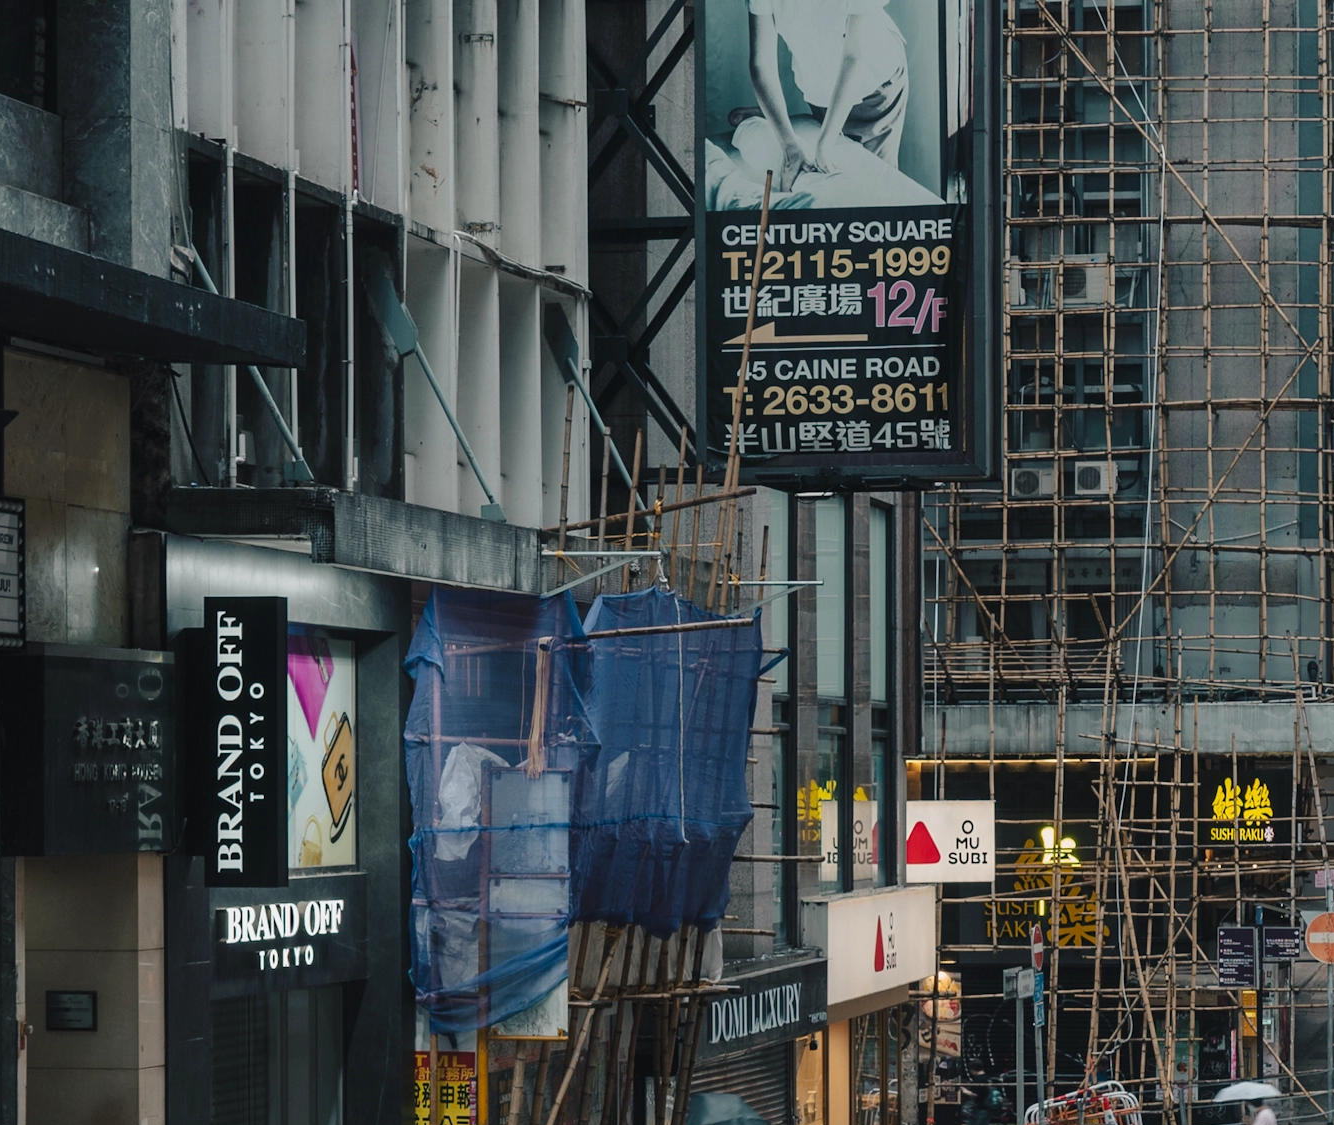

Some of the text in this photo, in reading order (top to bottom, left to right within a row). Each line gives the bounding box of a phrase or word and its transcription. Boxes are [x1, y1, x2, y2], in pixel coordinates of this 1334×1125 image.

[721, 218, 953, 246] CENTURY SQUARE
[721, 280, 949, 334] 世紀廣場 12/F
[736, 356, 941, 381] 45 CAINE ROAD
[216, 610, 243, 874] BRAND OFF
[249, 682, 265, 803] TOKYO
[74, 763, 159, 781] HONG KONG HOUSE
[961, 820, 974, 834] O
[1239, 827, 1264, 841] RAKU
[956, 837, 979, 849] MU
[948, 852, 988, 864] SUBI
[225, 899, 345, 944] BRAND OFF
[258, 945, 314, 972] TOKYO
[709, 982, 802, 1044] DOMI LUXURY
